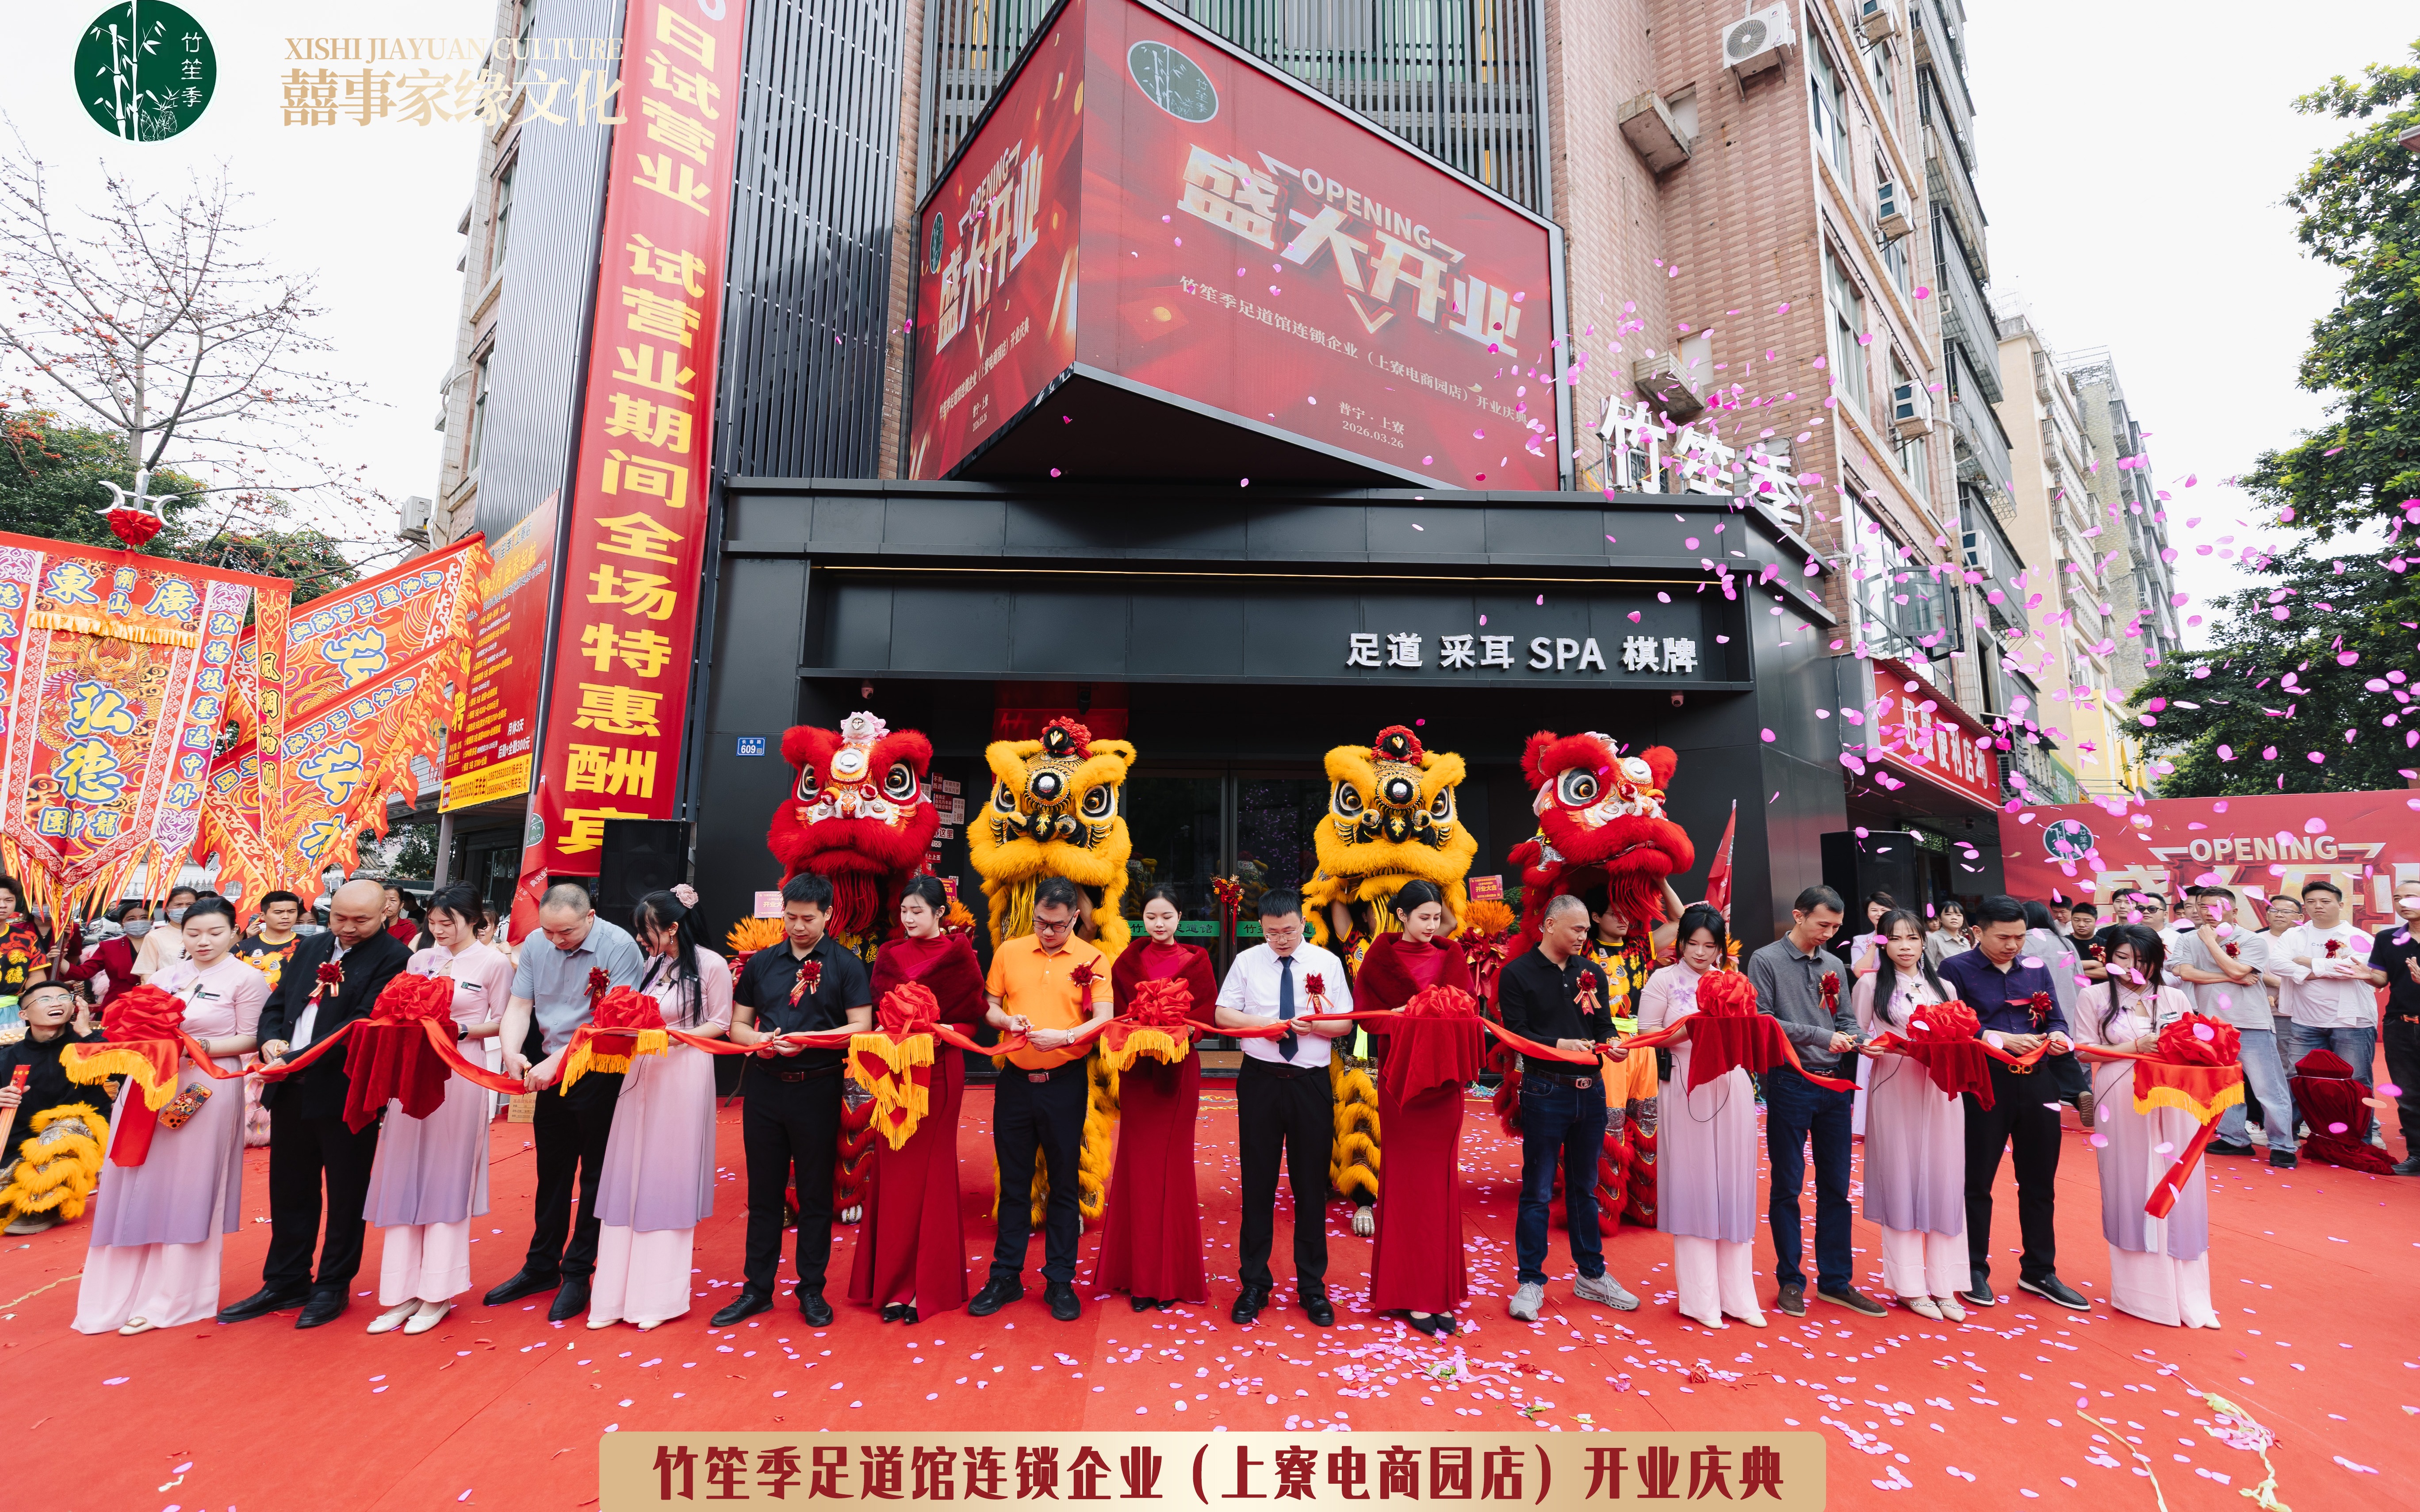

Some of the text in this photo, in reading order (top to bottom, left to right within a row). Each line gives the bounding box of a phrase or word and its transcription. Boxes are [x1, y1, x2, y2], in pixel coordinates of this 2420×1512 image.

[633, 0, 726, 217] 日试营业
[969, 147, 1010, 224] OPENING
[1302, 167, 1432, 246] OPENING
[936, 145, 1044, 355] 盛大开业
[1176, 143, 1521, 357] 盛大开业
[1342, 420, 1405, 449] 2026.03.26
[1596, 394, 1802, 525] 竹笙季
[503, 537, 538, 586] 盛装起航
[1346, 632, 1698, 673] 足道 采耳 SPA 棋牌
[53, 680, 137, 804] 弘德
[507, 716, 524, 737] 月休3天
[741, 745, 756, 754] 609
[2189, 836, 2339, 862] OPENING
[5, 949, 28, 984] 弘德
